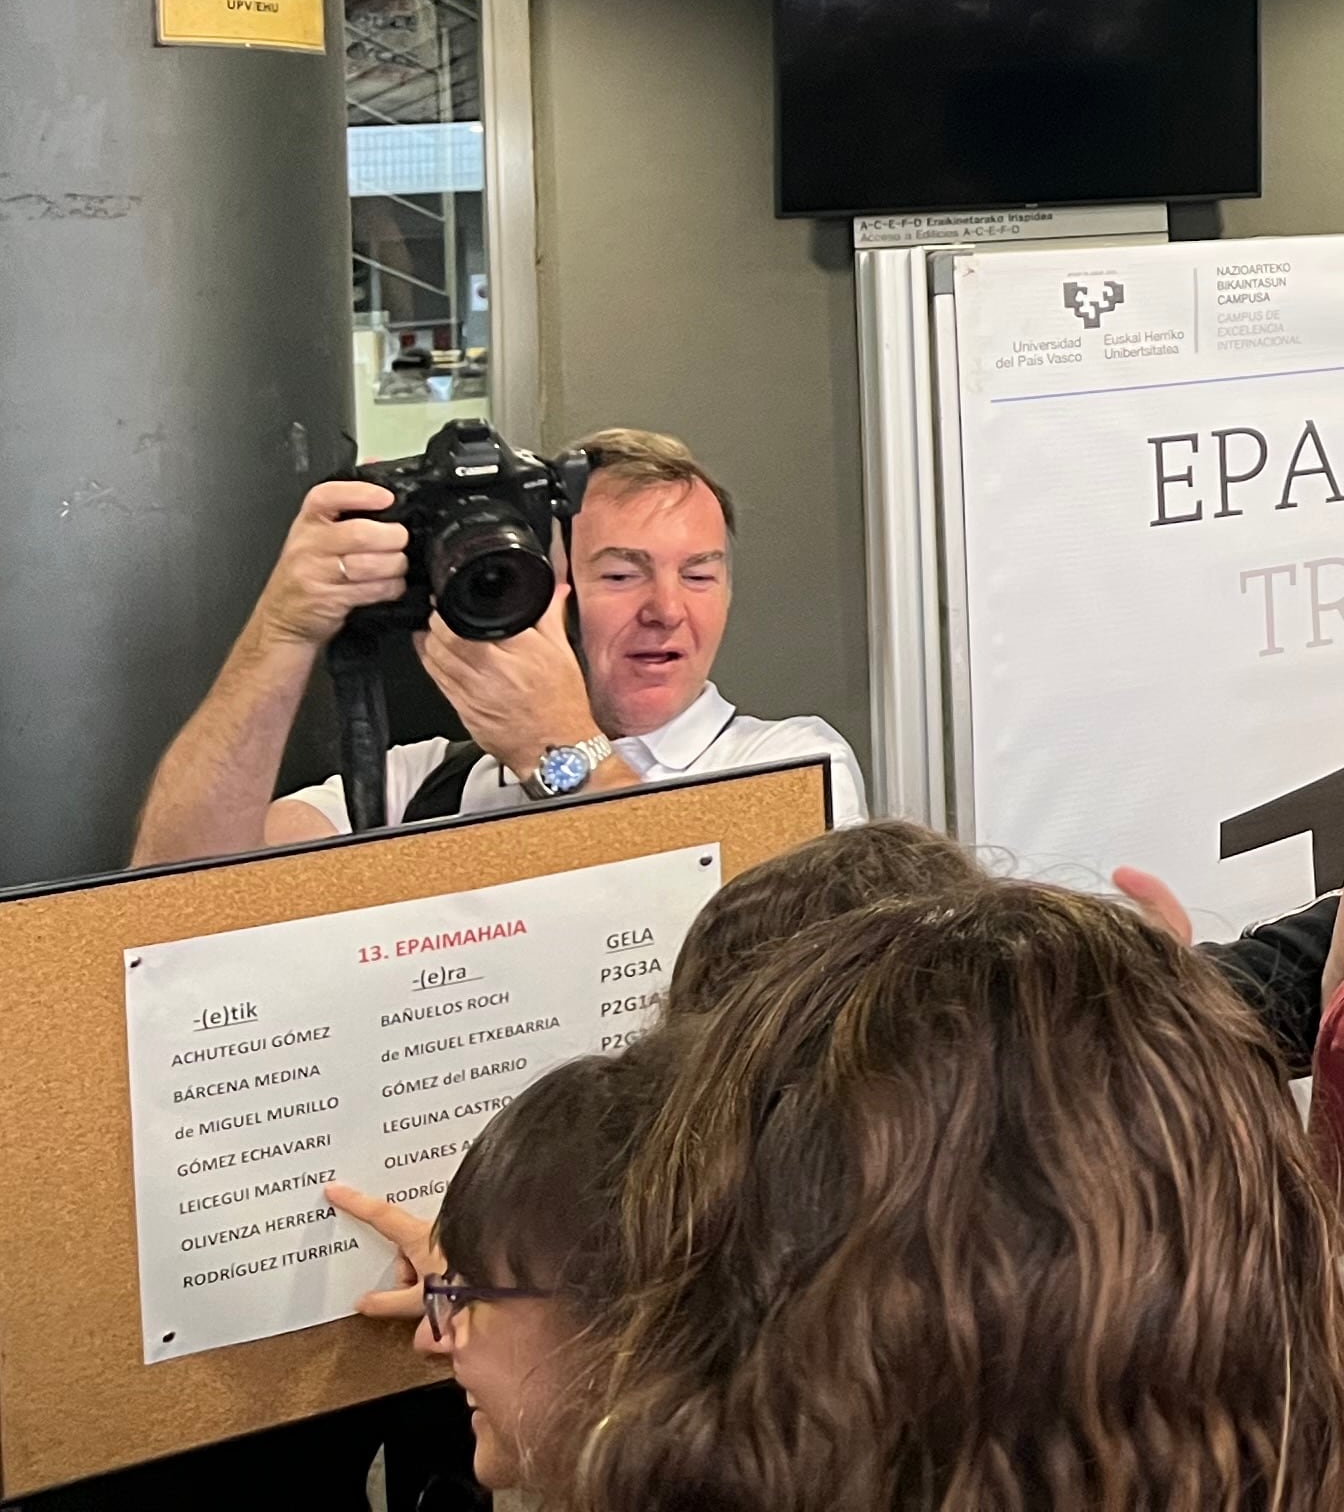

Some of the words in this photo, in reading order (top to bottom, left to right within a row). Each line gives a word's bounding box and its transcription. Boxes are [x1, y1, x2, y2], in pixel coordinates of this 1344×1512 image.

[860, 217, 922, 232] A-C-E-F-D
[962, 224, 1020, 238] A-C-E-F-D
[1216, 262, 1291, 276] NAZIOARTEKO
[1217, 276, 1287, 291] BIKAINTASUN
[1217, 292, 1271, 306] CAMPUSA
[1217, 310, 1262, 324] CAMPUS
[1265, 309, 1281, 321] DE
[1104, 331, 1142, 346] Euskal
[1144, 328, 1185, 343] Herriko
[1217, 323, 1284, 338] EXCELENCIA
[1012, 336, 1082, 354] Universidad
[1104, 344, 1180, 360] Unibertsitatea
[1217, 336, 1302, 351] INTERNACIONAL
[995, 354, 1014, 369] del
[1046, 351, 1083, 366] Vasco
[358, 944, 389, 964] 13.
[395, 919, 527, 957] EPAIMAHAIA
[606, 927, 654, 950] GELA
[412, 966, 467, 989] -(e)ra
[601, 958, 662, 984] P3G3A
[193, 1001, 258, 1030] -(e)tik
[380, 1000, 463, 1028] BAÑUELOS
[467, 991, 510, 1010] ROCH
[171, 1038, 267, 1067] ACHUTEGUI
[271, 1025, 331, 1049] GÓMEZ
[381, 1049, 400, 1063] de
[404, 1035, 465, 1058] MIGUEL
[468, 1017, 560, 1045] ETXEBARRIA
[173, 1078, 250, 1104] BÁRCENA
[254, 1064, 321, 1088] MEDINA
[382, 1075, 439, 1098] GÓMEZ
[443, 1069, 466, 1086] del
[470, 1057, 528, 1080] BARRIO
[175, 1126, 194, 1140] de
[199, 1112, 262, 1136] MIGUEL
[267, 1096, 339, 1122] MURILLO
[383, 1109, 450, 1134] LEGUINA
[454, 1095, 513, 1118] CASTRO
[177, 1153, 236, 1178] GÓMEZ
[241, 1134, 331, 1164] ECHAVARRI
[384, 1142, 457, 1169] OLIVARES
[179, 1187, 250, 1215] LEICEGUI
[254, 1169, 337, 1199] MARTÍNEZ
[386, 1180, 450, 1204] RODRÍG
[181, 1224, 261, 1252] OLIVENZA
[265, 1206, 337, 1233] HERRERA
[183, 1256, 278, 1288] RODRÍGUEZ
[282, 1238, 360, 1267] ITURRIRIA
